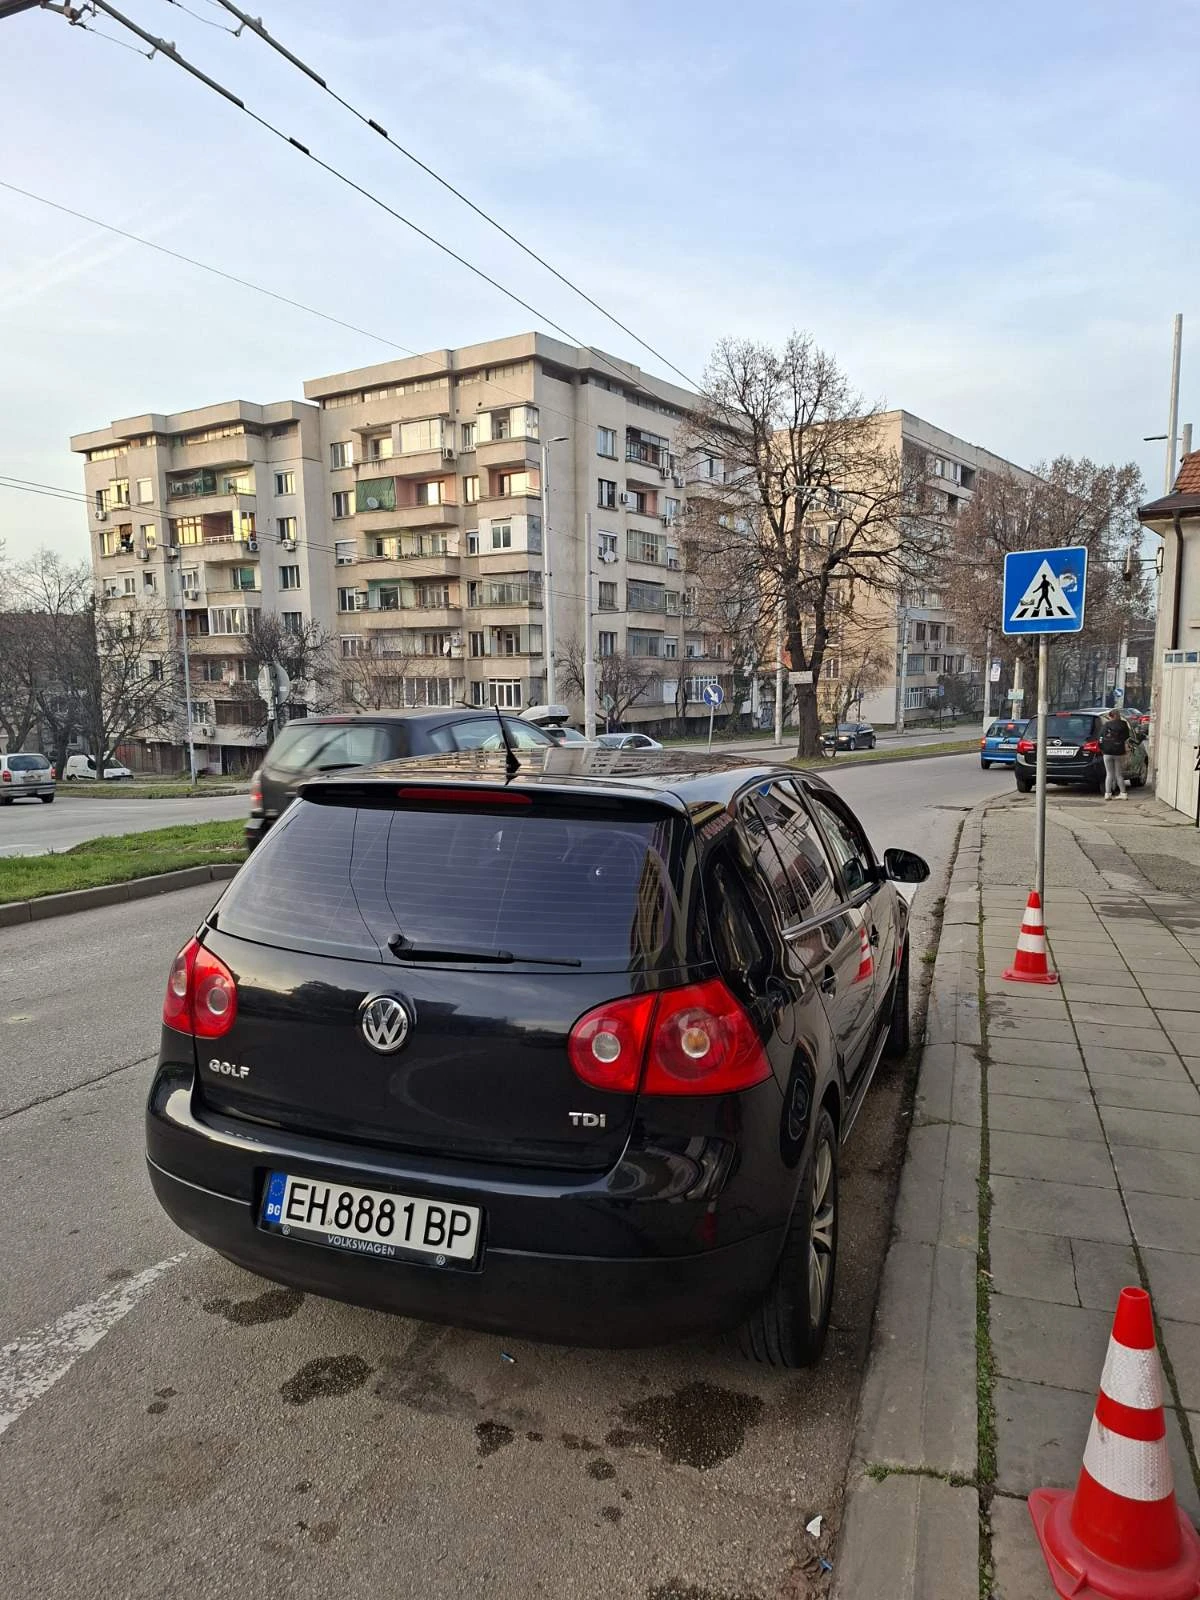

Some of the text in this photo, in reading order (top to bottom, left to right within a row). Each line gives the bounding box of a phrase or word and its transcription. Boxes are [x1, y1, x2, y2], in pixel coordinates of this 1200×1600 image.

[362, 998, 409, 1050] VW
[209, 1059, 250, 1079] GOLF
[267, 1203, 281, 1216] BG
[327, 1234, 396, 1256] VOLKSWAGEN
